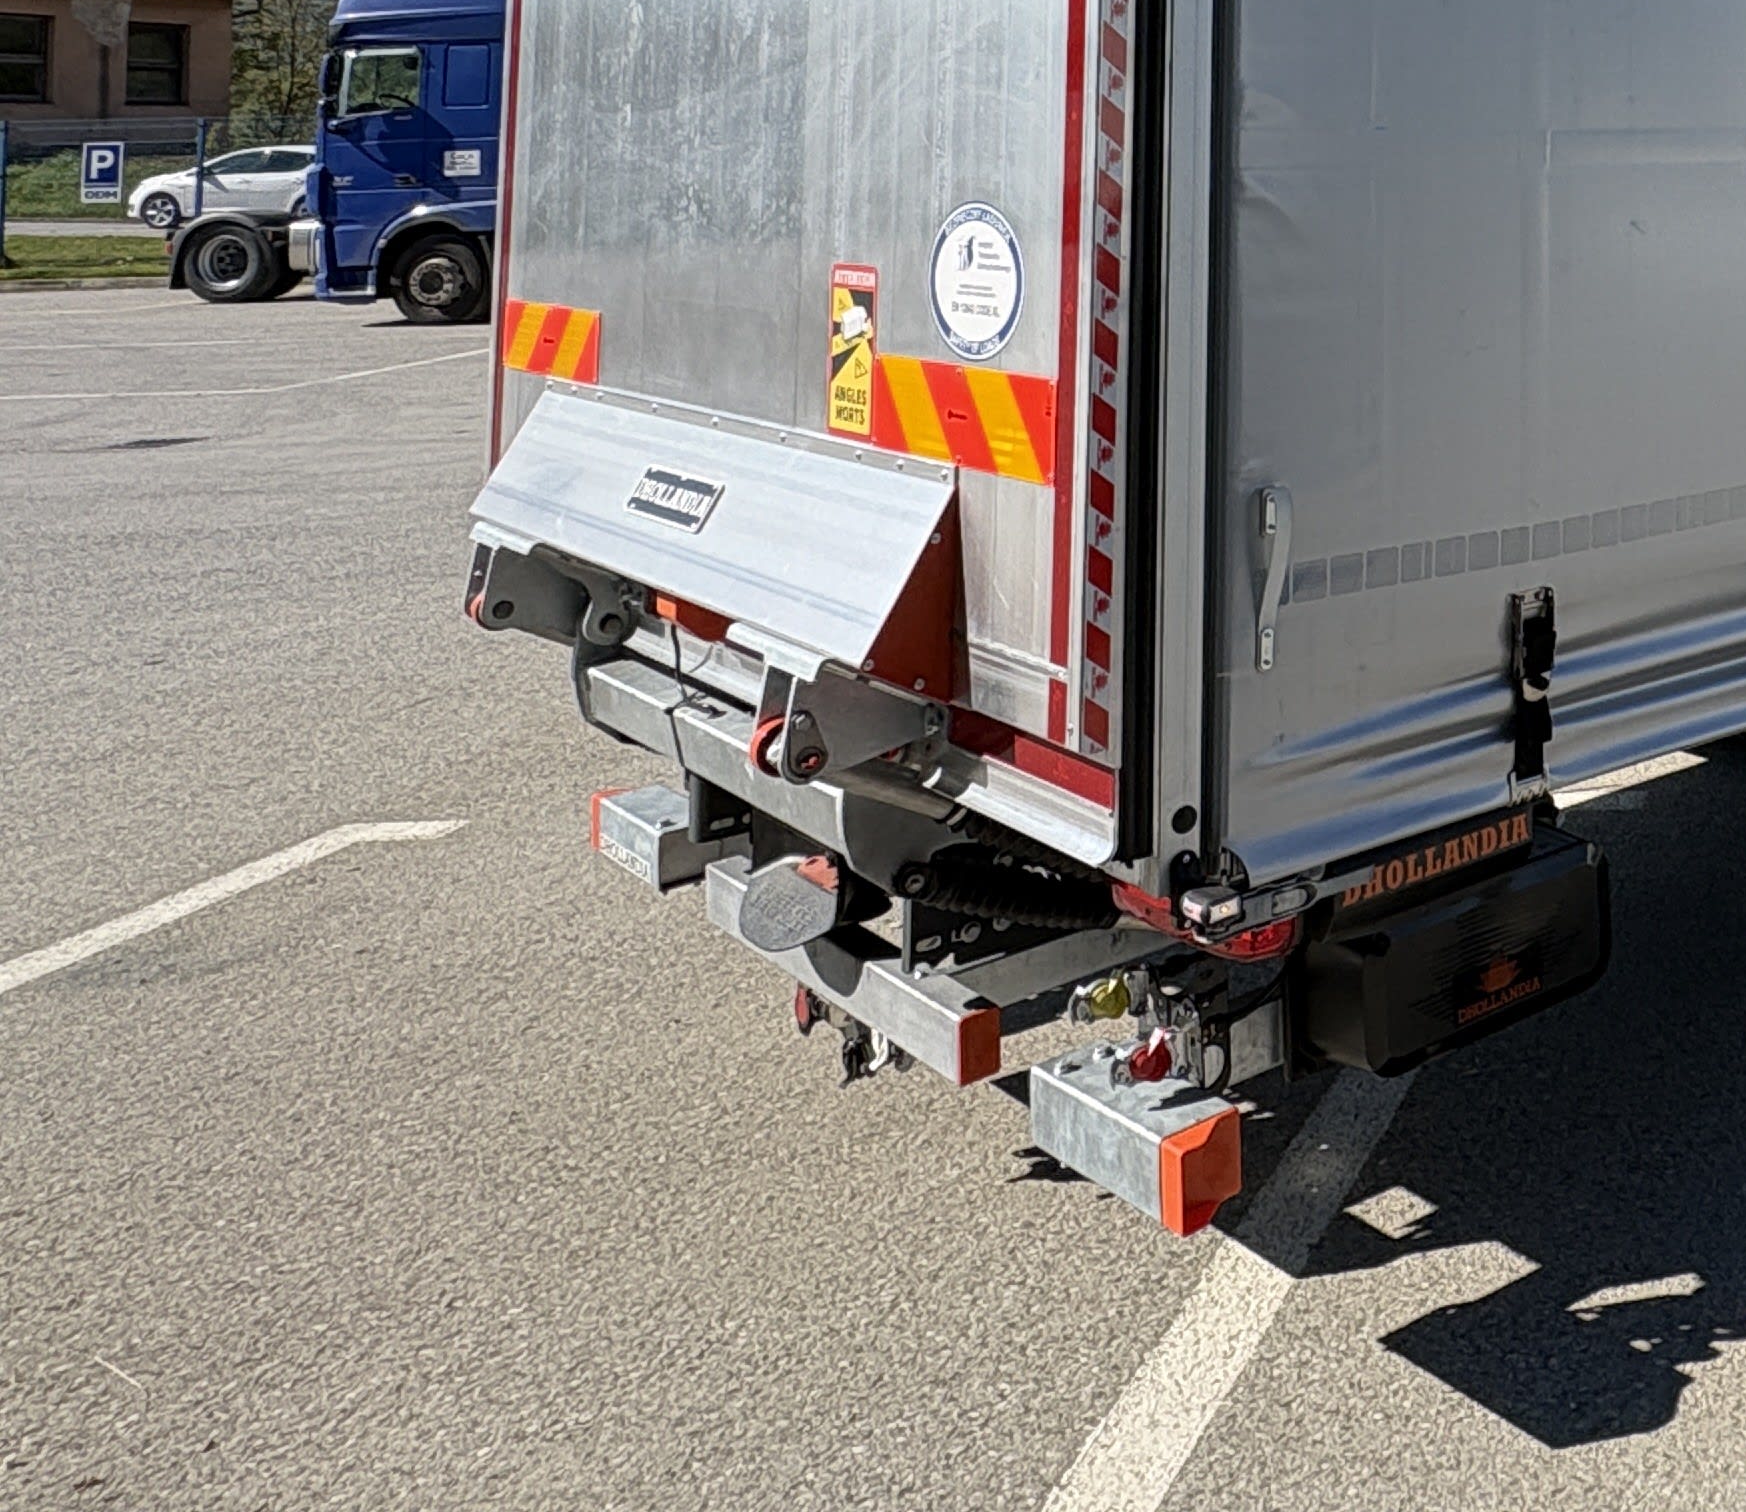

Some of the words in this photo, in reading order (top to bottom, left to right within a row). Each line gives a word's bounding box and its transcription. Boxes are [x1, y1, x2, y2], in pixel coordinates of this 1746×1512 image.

[90, 149, 114, 179] P
[835, 385, 867, 407] ANGLES
[835, 405, 866, 426] MORTS
